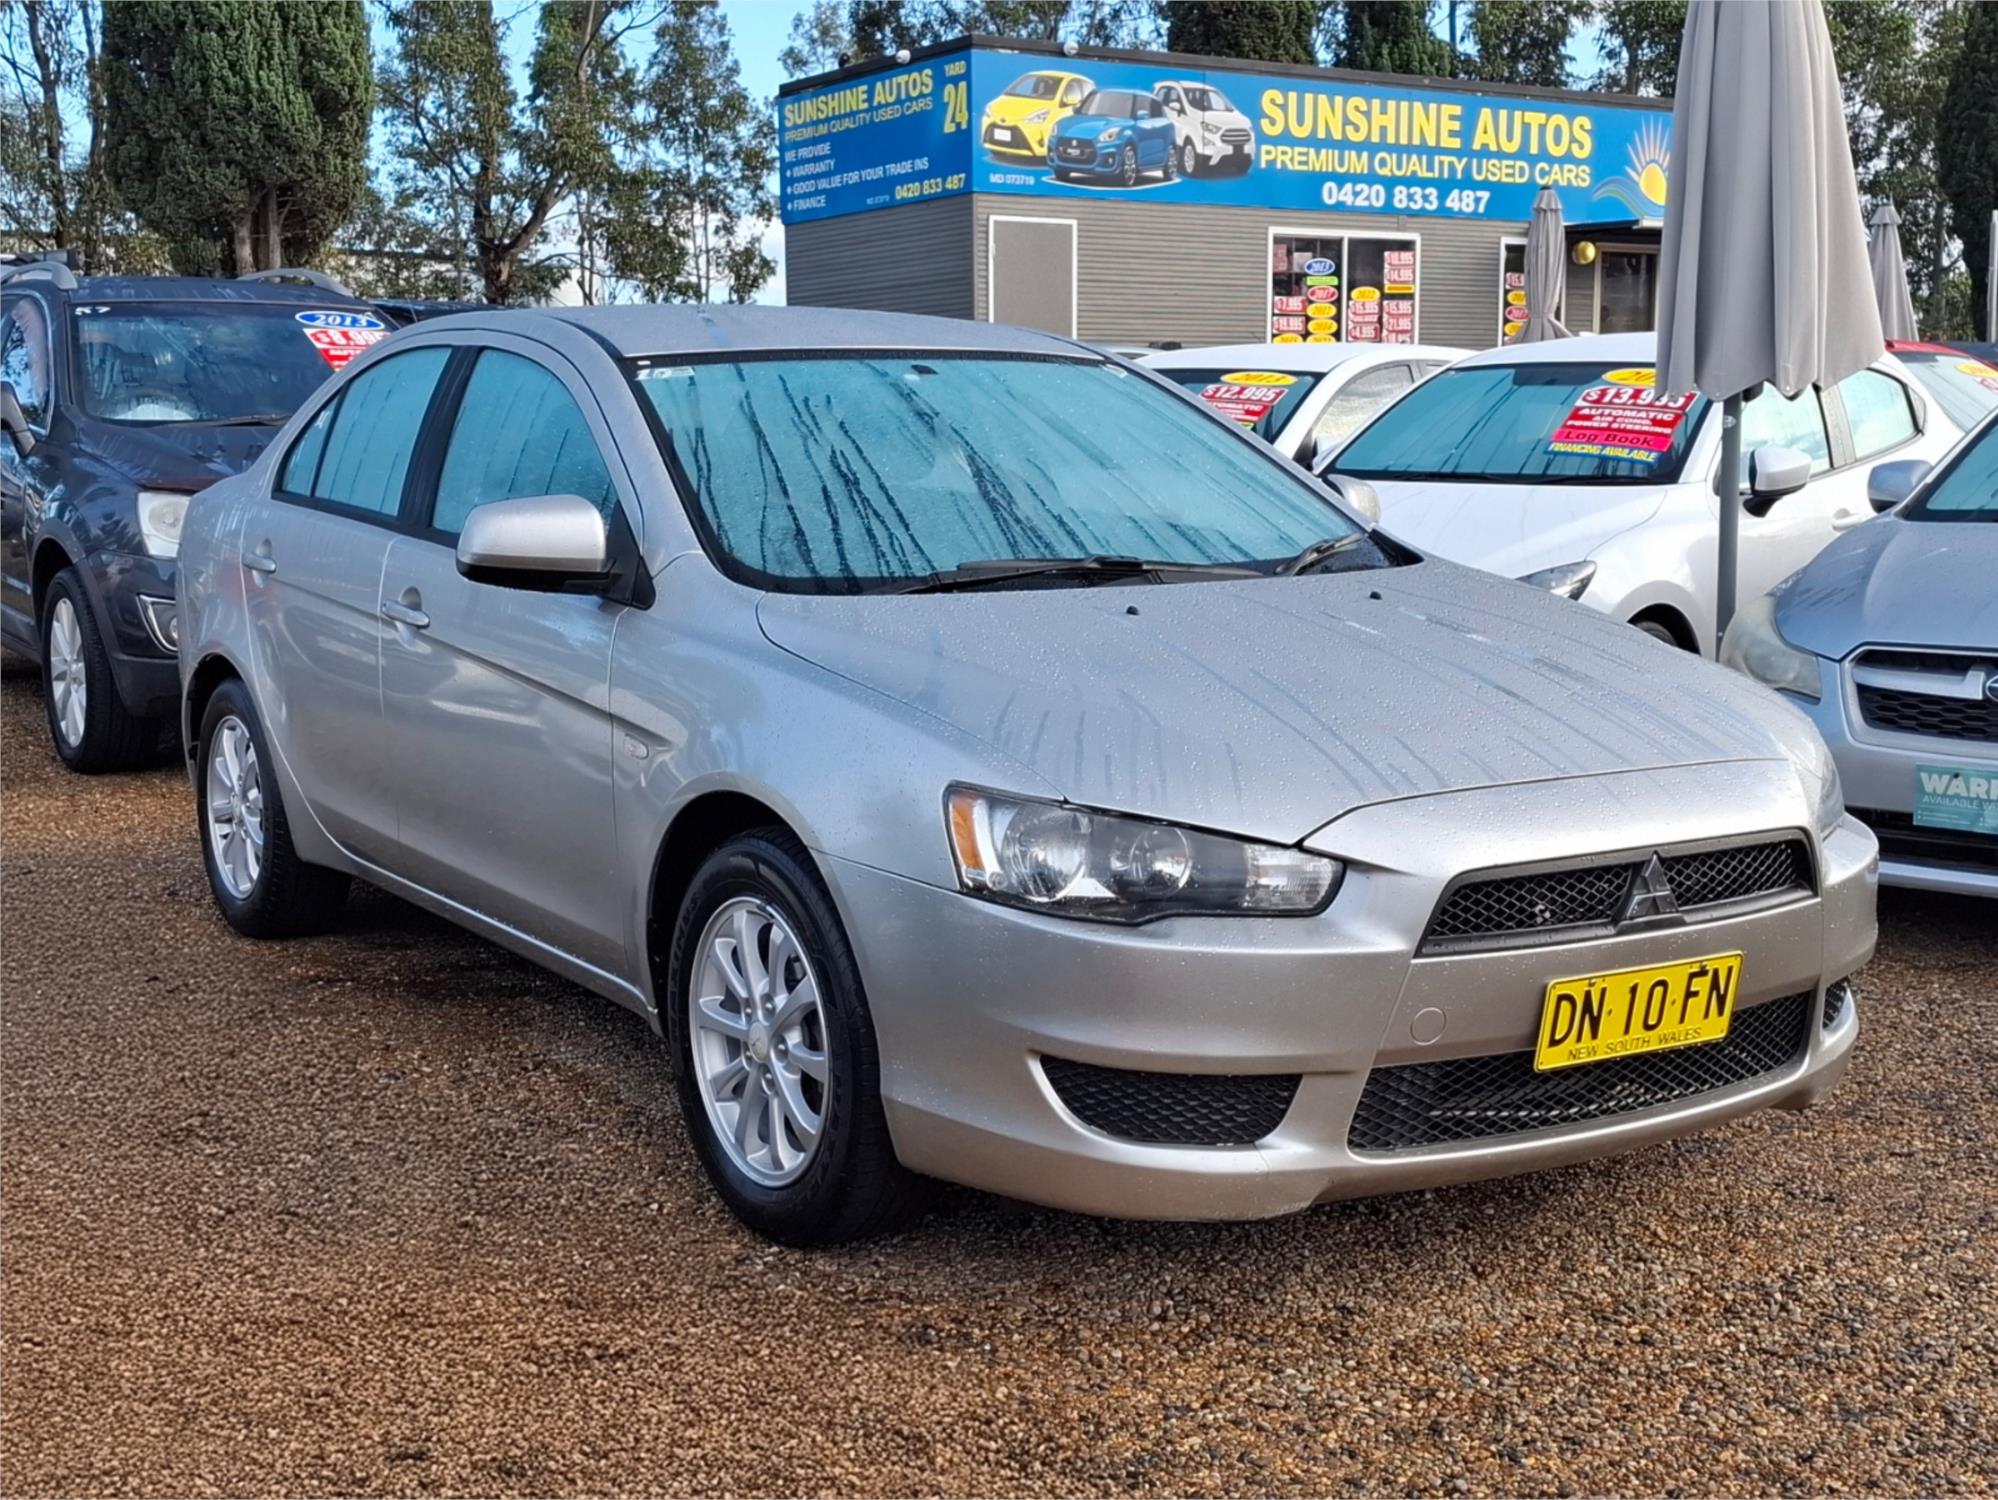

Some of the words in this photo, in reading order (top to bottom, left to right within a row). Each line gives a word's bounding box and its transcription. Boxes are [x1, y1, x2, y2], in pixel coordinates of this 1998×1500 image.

[944, 60, 967, 77] YARD
[785, 86, 868, 127] SUNSHINE
[873, 68, 934, 107] AUTOS
[943, 81, 969, 133] 24
[785, 122, 828, 143] PREMIUM
[829, 112, 872, 134] QUALITY
[873, 105, 902, 122] USED
[903, 96, 934, 115] CARS
[1260, 89, 1461, 149] SUNSHINE
[1472, 108, 1593, 159] AUTOS
[784, 149, 797, 163] WE
[798, 142, 832, 160] PROVIDE
[793, 159, 836, 178] WARRANTY
[793, 180, 816, 195] GOOD
[817, 173, 842, 190] VALUE
[843, 171, 860, 185] FOR
[861, 166, 885, 182] YOUR
[886, 160, 913, 177] TRADE
[914, 156, 930, 172] INS
[1260, 144, 1369, 176] PREMIUM
[1373, 154, 1468, 182] QUALITY
[1472, 162, 1530, 185] USED
[1534, 164, 1592, 188] CARS
[895, 185, 920, 200] 0420
[923, 178, 943, 195] 833
[945, 173, 966, 190] 487
[1322, 182, 1386, 208] 0420
[1393, 186, 1439, 210] 833
[1446, 189, 1491, 214] 487
[793, 195, 826, 211] FINANCE
[1204, 386, 1277, 401] $12,995
[1212, 403, 1264, 411] TOMATIC
[1579, 408, 1676, 421] AUTOMATIC
[1565, 432, 1599, 442] Log
[1604, 434, 1654, 447] Book
[1611, 423, 1673, 433] STEERING
[1923, 795, 1979, 809] AVAILABLE
[1548, 987, 1607, 1048] DN
[1623, 979, 1669, 1036] 10
[1679, 965, 1734, 1024] FN
[1567, 1047, 1599, 1061] NEW
[1604, 1038, 1650, 1055] SOUTH
[1658, 1027, 1701, 1044] WALES
